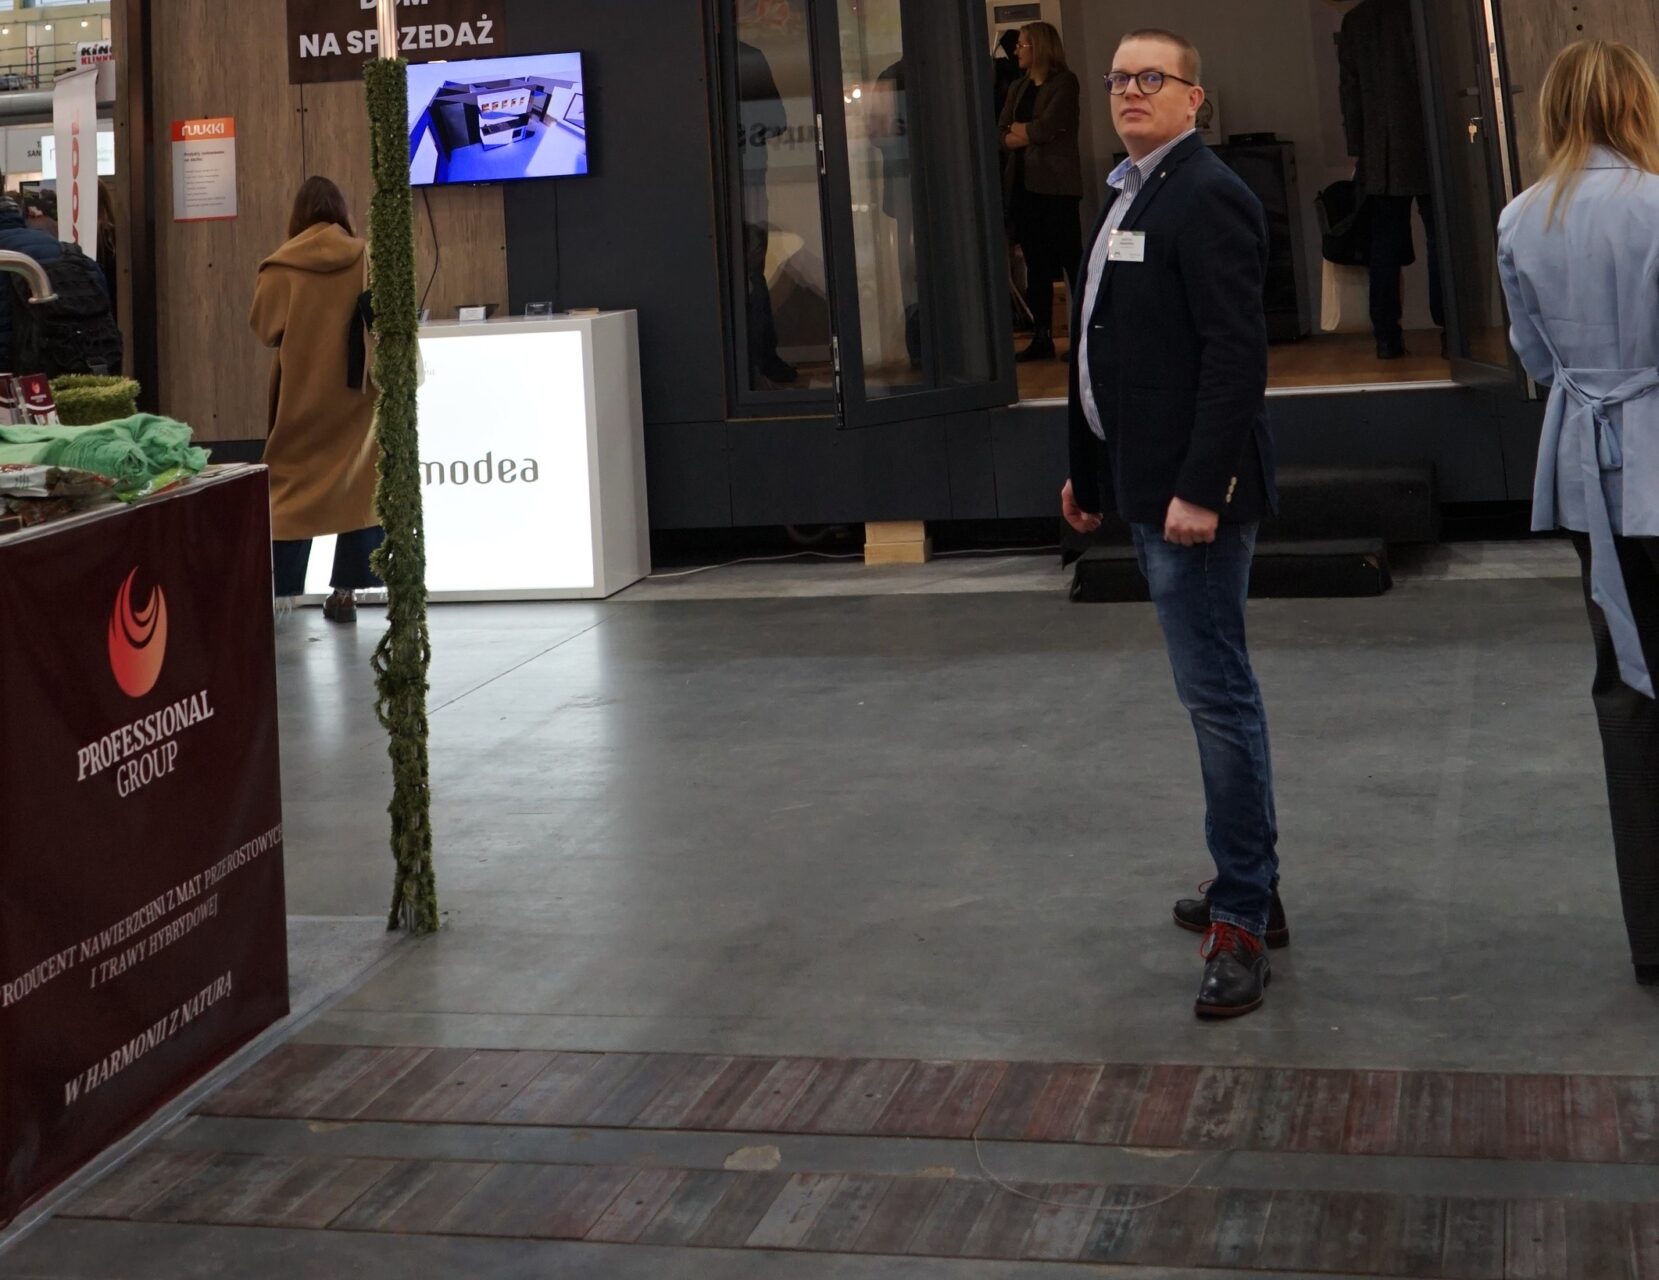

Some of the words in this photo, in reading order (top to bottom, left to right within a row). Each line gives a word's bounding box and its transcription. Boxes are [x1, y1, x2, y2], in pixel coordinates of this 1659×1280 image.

[300, 33, 342, 58] NA
[347, 13, 494, 54] SPZEDAŻ
[419, 451, 539, 486] modea
[77, 690, 214, 782] PROFESSIONAL
[116, 740, 178, 798] GROUP
[0, 945, 78, 1008] RODUCENT
[79, 895, 166, 963] NAWIERZCHNI
[166, 890, 177, 912] Z
[176, 873, 202, 906] MAT
[90, 967, 97, 990] I
[100, 940, 148, 984] TRAWY
[149, 893, 219, 957] HYBRYDOWEJ
[65, 1074, 83, 1106] W
[85, 1016, 168, 1094] HARMONII
[168, 1008, 180, 1037] Z
[180, 970, 233, 1027] NATURĄ
